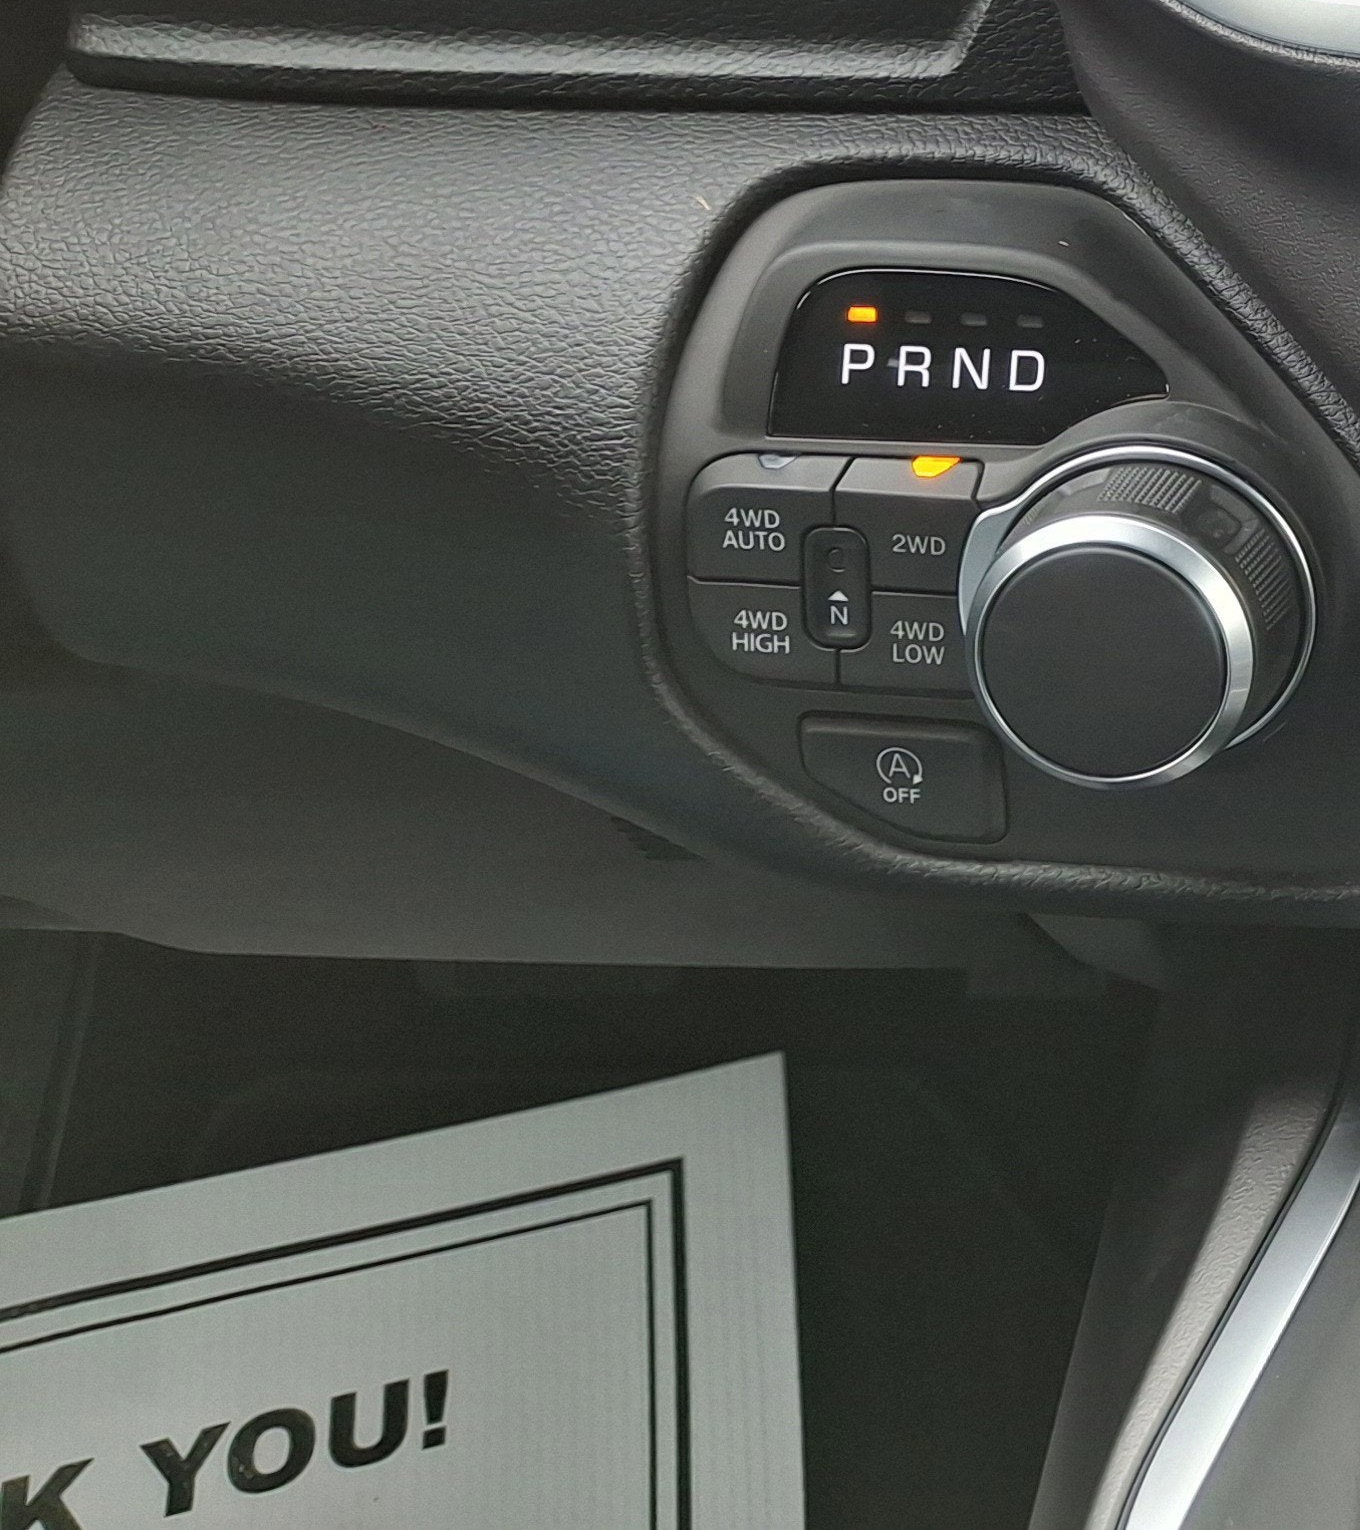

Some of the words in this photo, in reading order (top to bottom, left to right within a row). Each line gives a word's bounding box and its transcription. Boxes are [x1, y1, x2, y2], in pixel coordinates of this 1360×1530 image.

[724, 507, 780, 529] 4WD
[722, 531, 786, 551] AUTO
[892, 534, 946, 556] 2WD
[734, 610, 787, 631] 4WD
[830, 607, 848, 625] N
[890, 621, 944, 642] 4WD
[732, 633, 790, 654] HIGH
[892, 644, 945, 665] LOW
[883, 788, 921, 804] OFF
[141, 1370, 449, 1517] YOU!
